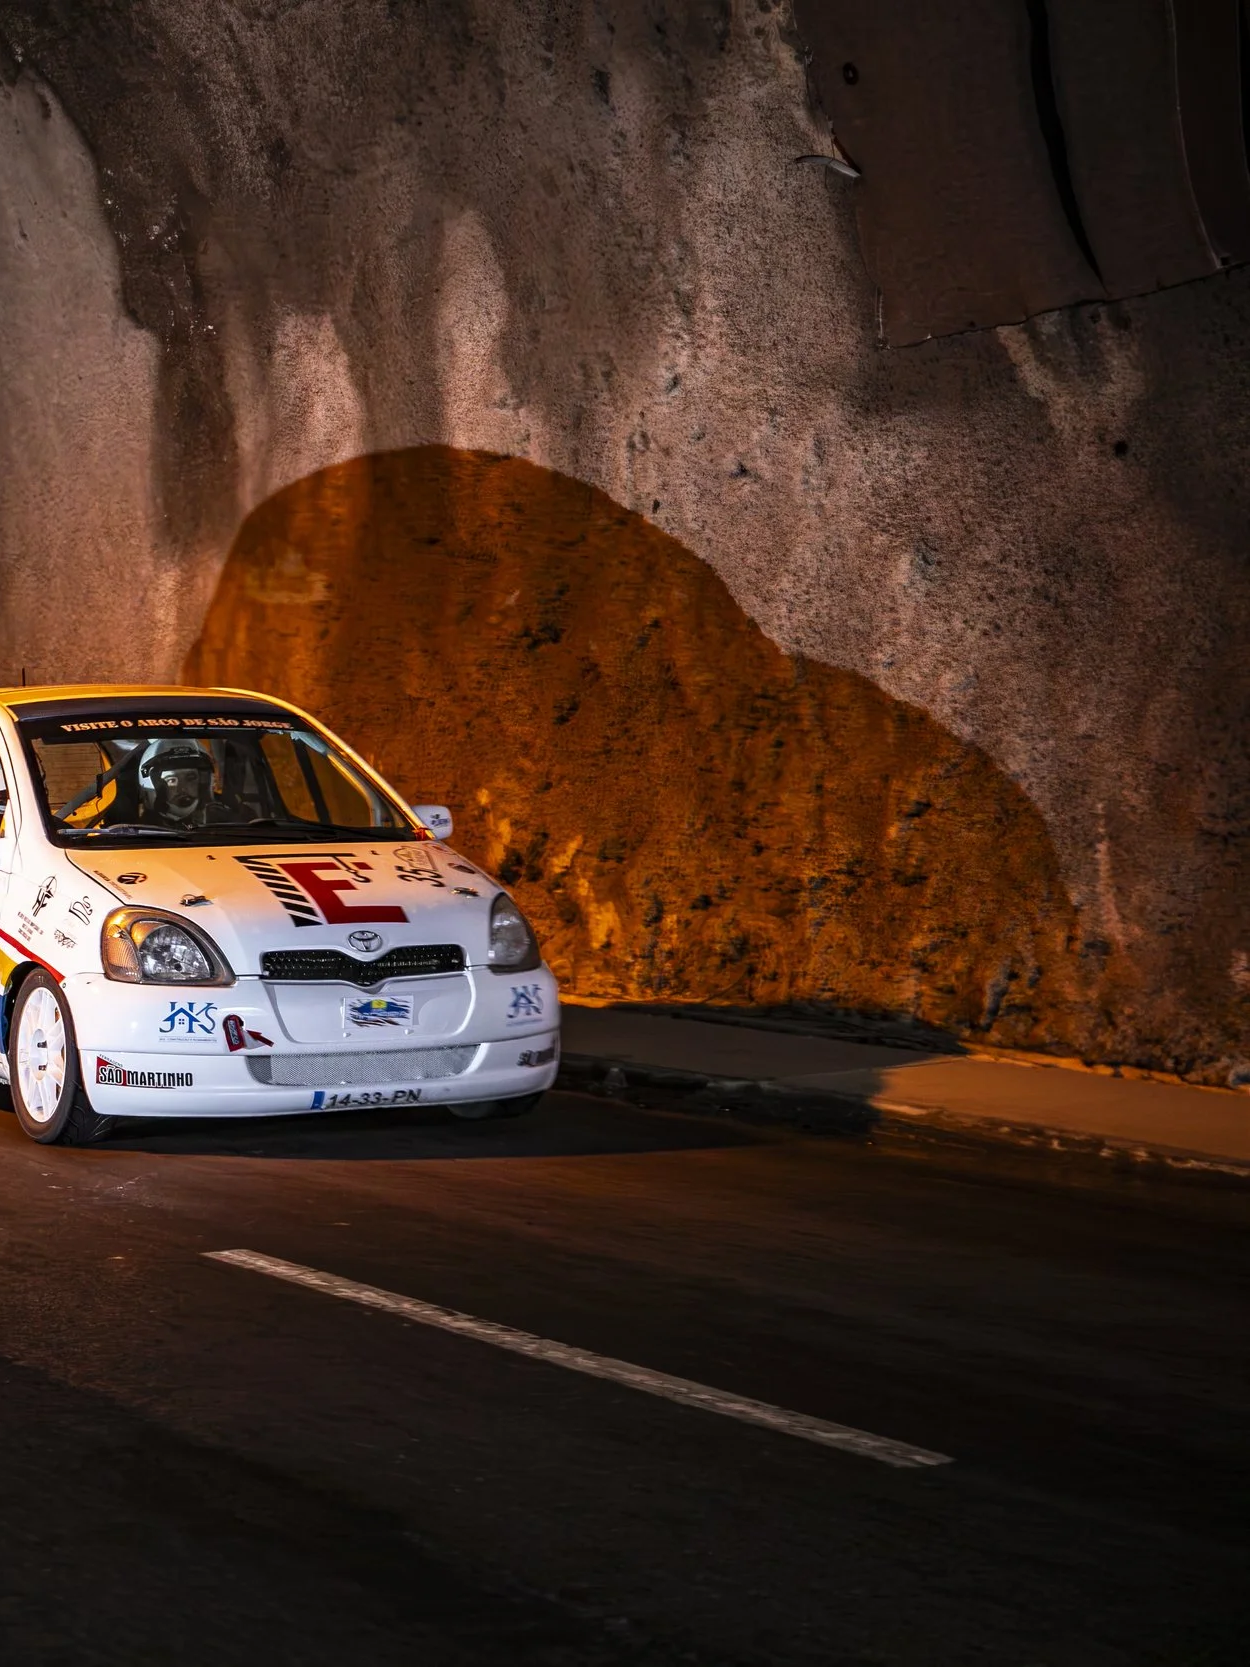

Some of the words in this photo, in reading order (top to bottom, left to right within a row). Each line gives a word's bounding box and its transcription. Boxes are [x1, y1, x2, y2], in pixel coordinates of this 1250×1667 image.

[60, 721, 119, 732] VISITE
[137, 719, 181, 727] ARCO
[206, 717, 240, 726] SÃO
[242, 719, 295, 729] JORGE
[100, 1065, 123, 1084] SÃO
[127, 1070, 193, 1087] MARTINHO
[328, 1088, 423, 1107] 14-33-PN
